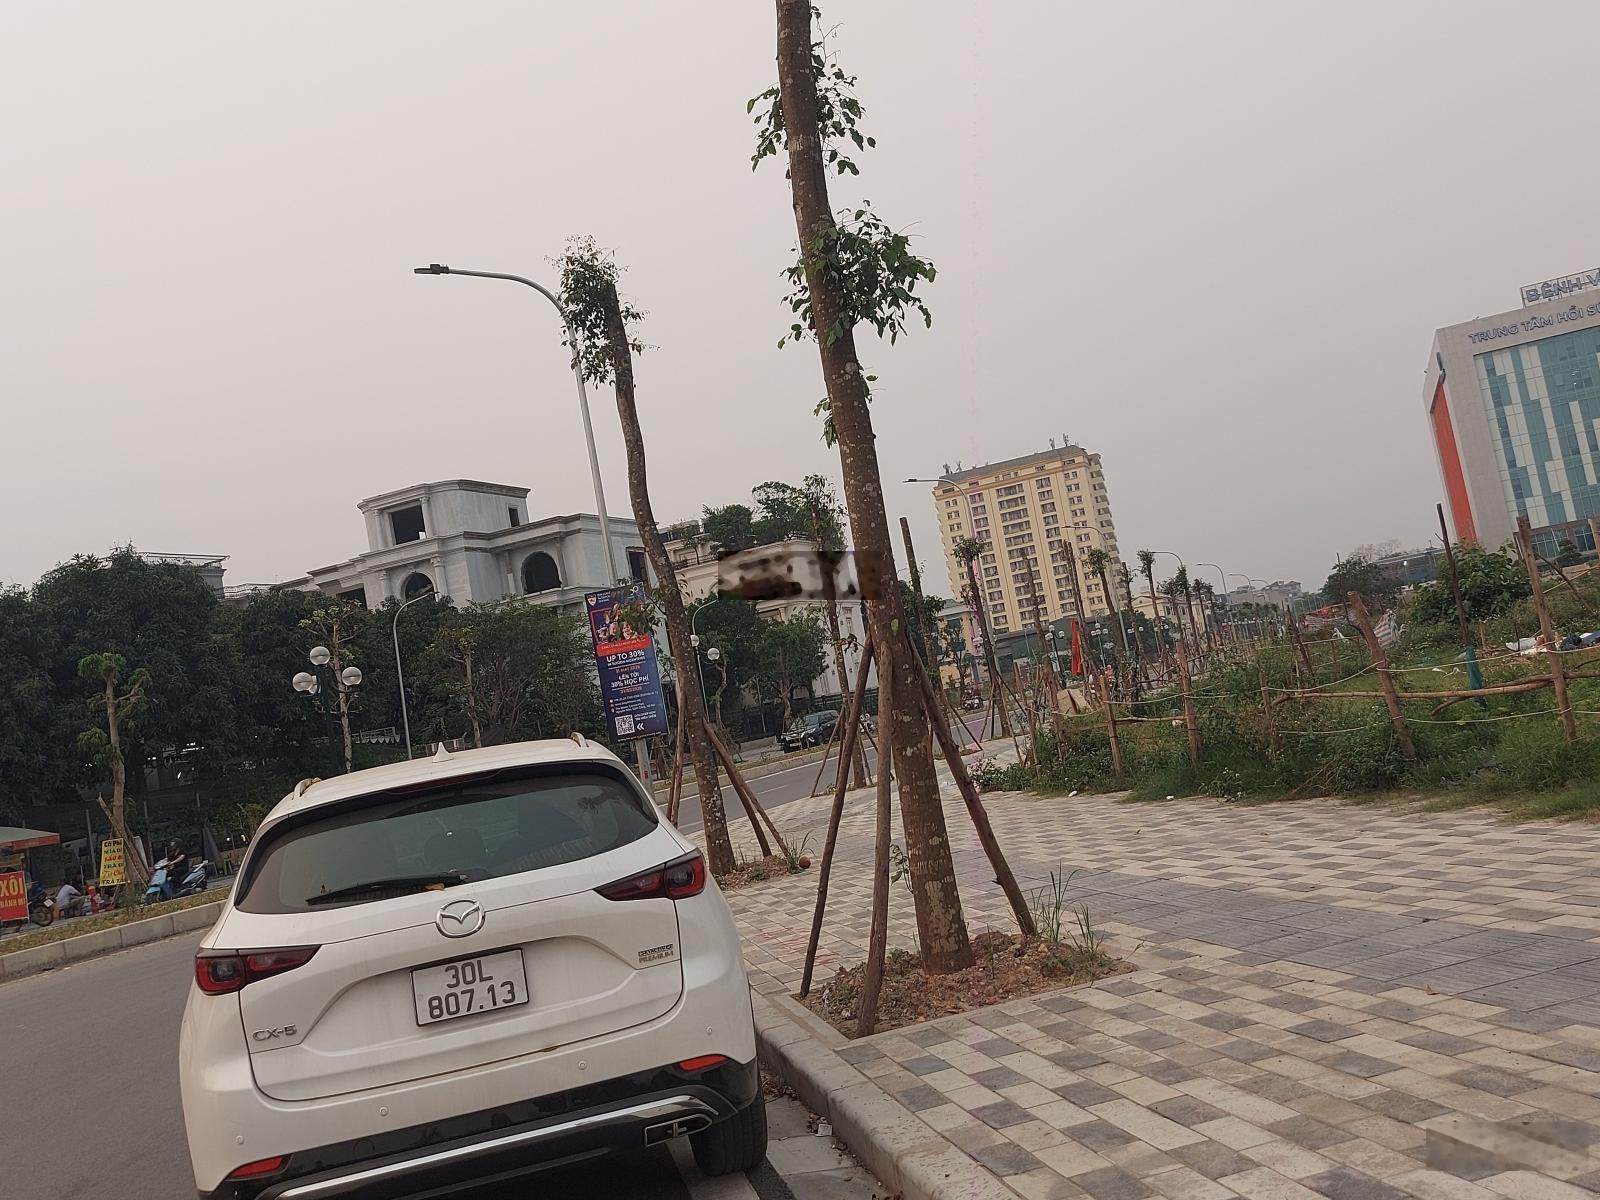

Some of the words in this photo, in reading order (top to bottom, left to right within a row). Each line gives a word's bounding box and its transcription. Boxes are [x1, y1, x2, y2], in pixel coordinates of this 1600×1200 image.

[1525, 279, 1583, 302] BỆNH
[1470, 325, 1519, 344] TRUNG
[1522, 316, 1554, 331] TÂM
[1557, 305, 1584, 323] HỒI
[628, 649, 645, 658] 30%
[624, 678, 638, 686] HỌC
[638, 674, 649, 682] PHÍ
[0, 876, 24, 897] XÔI
[639, 951, 673, 963] PREMIUM
[445, 960, 493, 988] 30L
[428, 981, 516, 1019] 807.13
[253, 1024, 297, 1042] CX-5
